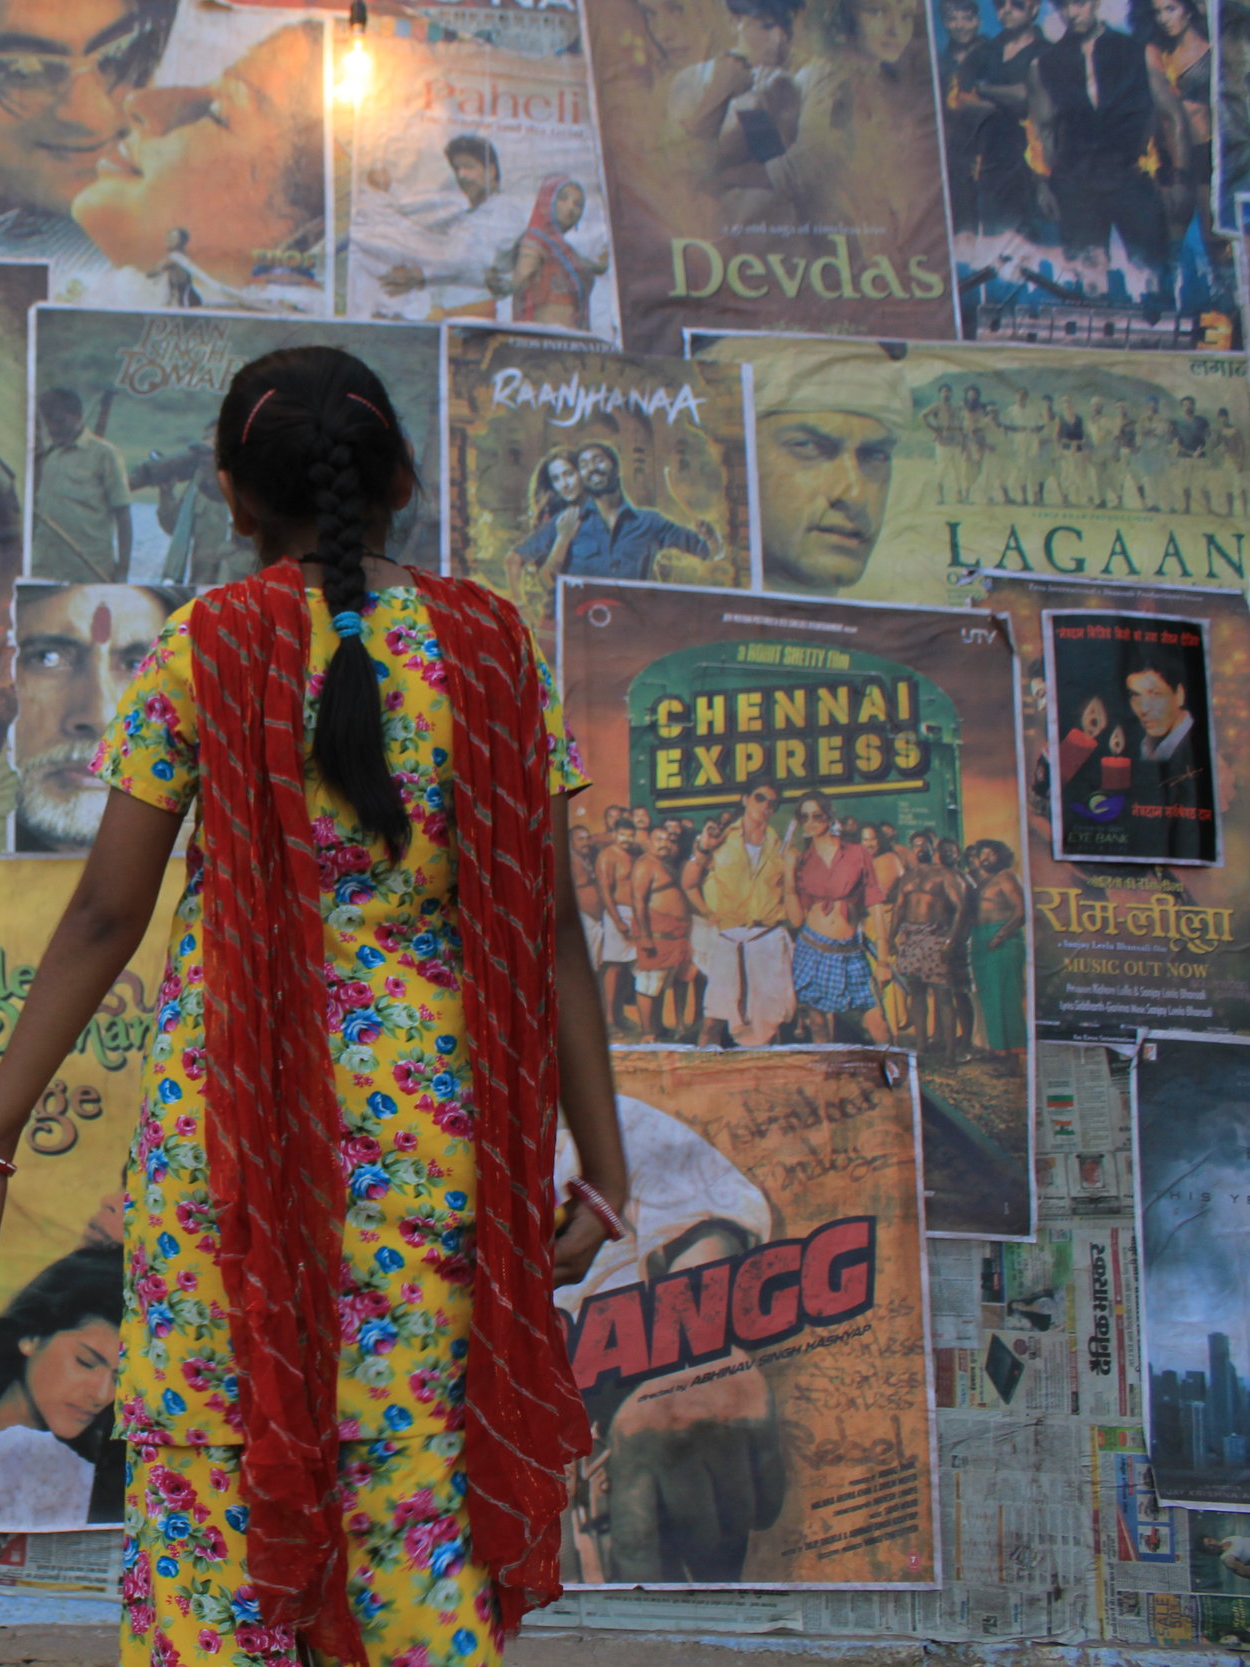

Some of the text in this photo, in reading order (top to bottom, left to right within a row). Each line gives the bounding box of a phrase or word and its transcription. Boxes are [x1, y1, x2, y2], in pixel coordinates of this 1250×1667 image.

[423, 79, 581, 125] Paheli
[668, 234, 945, 299] Devdas
[139, 316, 230, 348] PAAN
[152, 341, 232, 364] SINGH
[491, 367, 710, 427] RAANJHANAA
[945, 521, 1246, 580] LAGAAN
[783, 645, 826, 668] SHETTY
[961, 627, 997, 644] UTV
[656, 680, 912, 739] CHENNAI
[656, 731, 922, 790] EXPRESS
[1034, 887, 1235, 954] राम-लीला
[1063, 957, 1210, 978] MUSIC OUT NOW
[556, 1217, 873, 1392] ANGG
[690, 1360, 755, 1387] ABHINAV
[757, 1345, 803, 1367] SINGH
[804, 1324, 873, 1353] KASHYAP
[1087, 1315, 1112, 1376] दैनिक
